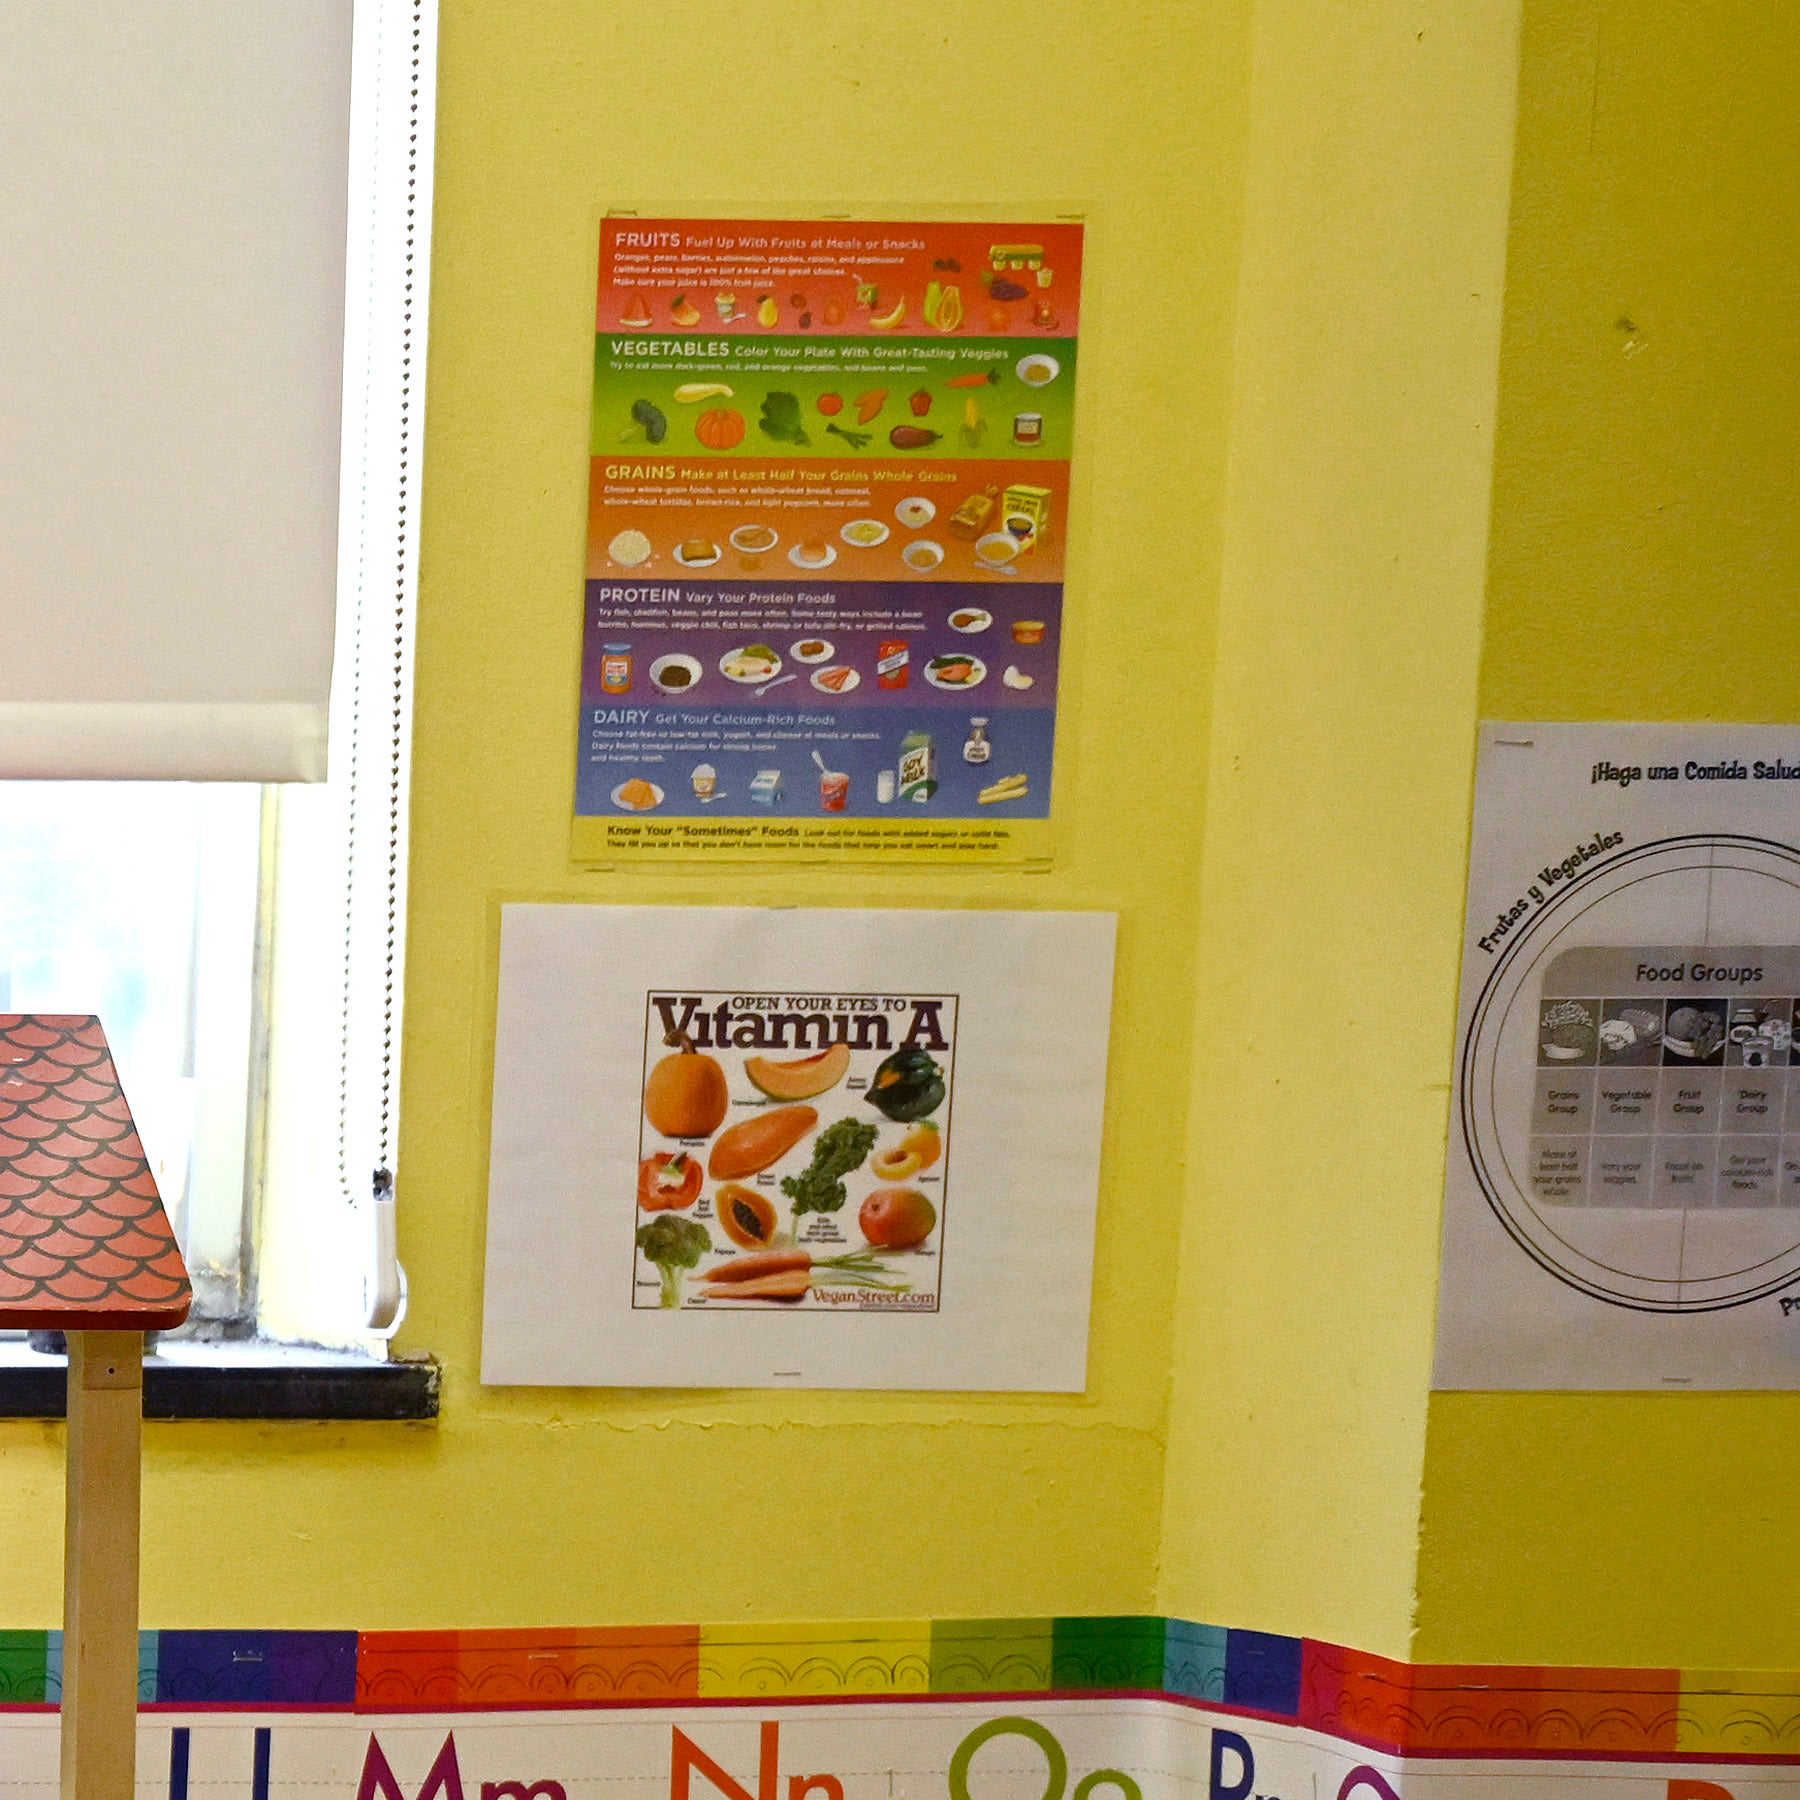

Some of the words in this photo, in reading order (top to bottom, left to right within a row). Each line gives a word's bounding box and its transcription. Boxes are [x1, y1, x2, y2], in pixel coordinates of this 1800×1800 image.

[616, 232, 680, 247] FRUITS
[686, 237, 712, 248] Fuel
[717, 237, 734, 249] Up
[739, 237, 767, 248] With
[771, 237, 806, 248] Fruits
[811, 239, 822, 248] at
[827, 238, 861, 249] Meals
[866, 240, 878, 249] or
[883, 239, 925, 249] Snacks
[612, 341, 729, 356] VEGETABLES
[735, 346, 768, 357] Color
[774, 347, 800, 357] Your
[805, 347, 835, 358] Plate
[842, 347, 869, 357] With
[874, 348, 955, 360] Great-Tasting
[961, 348, 1009, 360] Veggies
[605, 465, 676, 479] GRAINS
[681, 469, 713, 480] Make
[717, 470, 728, 480] at
[733, 469, 766, 481] Least
[770, 469, 794, 481] Half
[800, 470, 825, 481] Your
[830, 470, 868, 481] Grains
[874, 471, 913, 481] Whole
[918, 471, 957, 482] Grains
[601, 588, 680, 603] PROTEIN
[686, 592, 713, 604] Vary
[718, 593, 745, 603] Your
[749, 593, 793, 603] Protein
[797, 593, 836, 603] Foods
[594, 710, 649, 724] DAIRY
[656, 714, 677, 724] Get
[682, 714, 708, 724] Your
[713, 714, 793, 725] Calcium-Rich
[798, 714, 835, 725] Foods
[903, 752, 924, 773] SOY
[1591, 761, 1641, 787] ¡Haga
[1648, 766, 1678, 780] una
[1684, 760, 1747, 780] Comida
[607, 826, 641, 835] Know
[646, 826, 672, 836] Your
[762, 826, 799, 836] Foods
[1478, 898, 1529, 954] Frutas
[1528, 885, 1545, 905] y
[1537, 831, 1624, 886] Vegetales
[1636, 963, 1685, 982] Food
[1690, 963, 1763, 985] Groups
[732, 996, 780, 1011] OPEN
[786, 997, 832, 1011] YOUR
[836, 998, 878, 1012] EYES
[882, 1000, 907, 1012] TO
[652, 997, 893, 1050] Vitamin
[900, 1001, 949, 1050] A
[813, 1289, 935, 1304] VeganStreet.com
